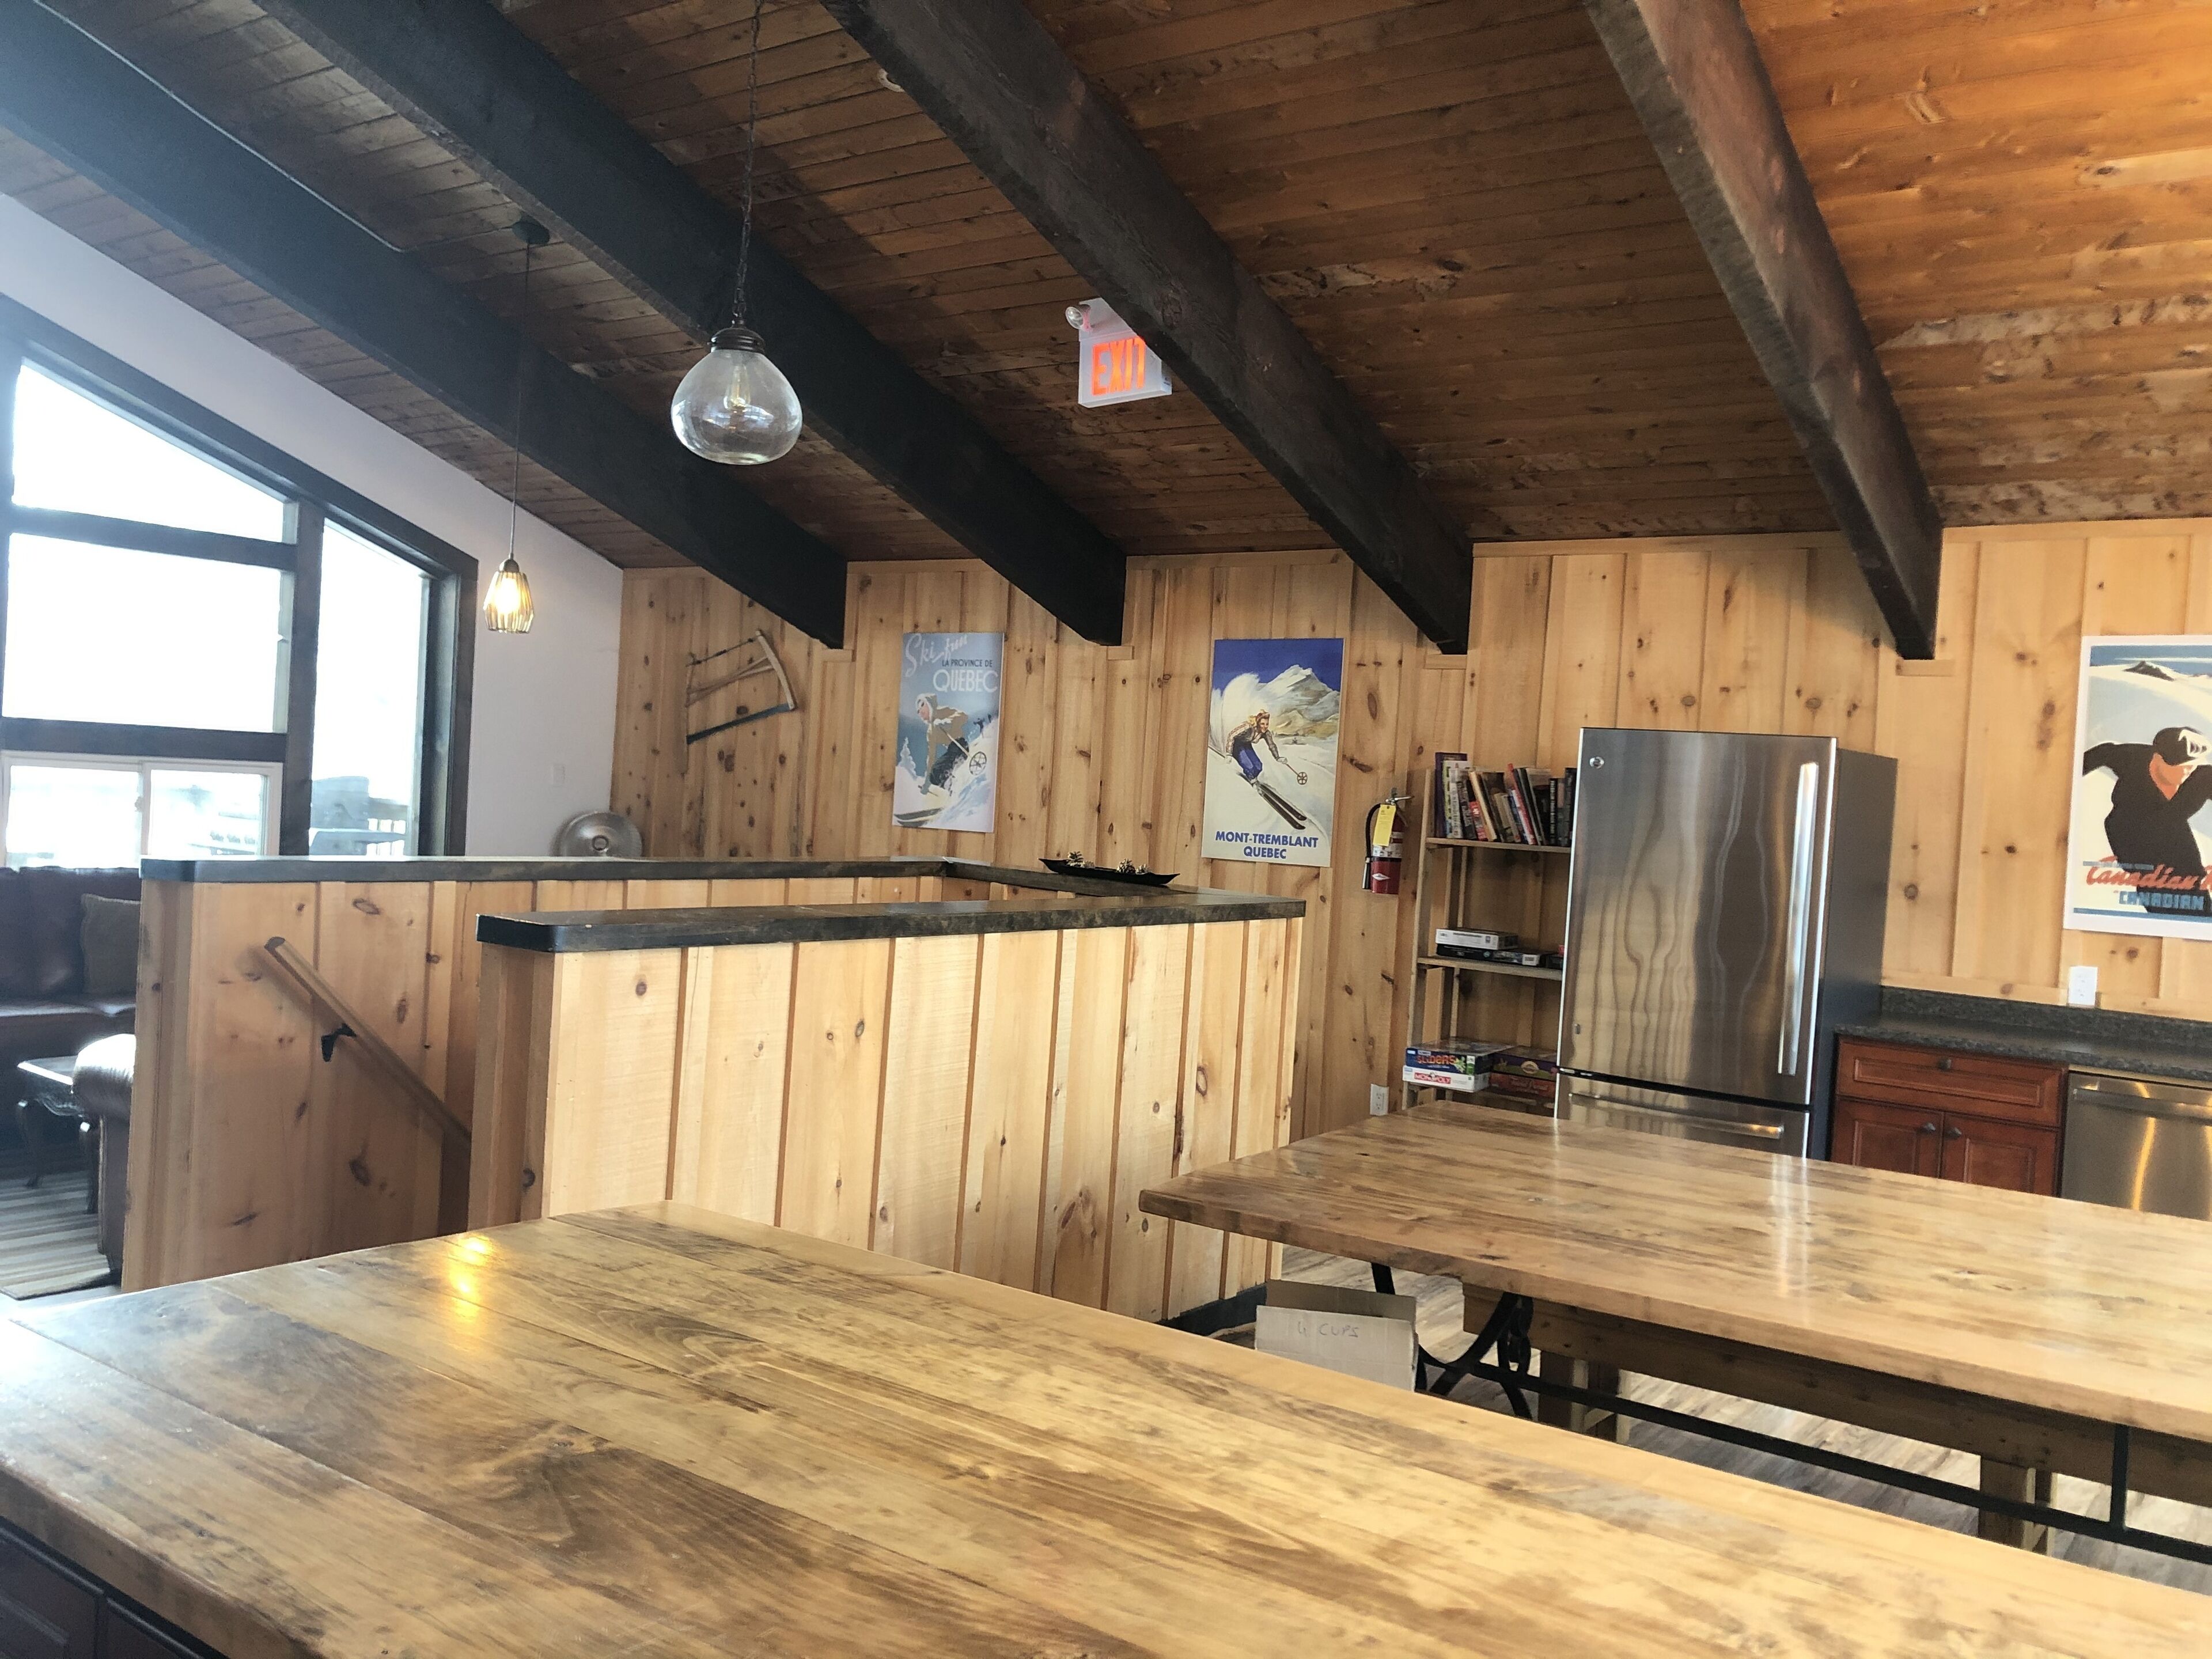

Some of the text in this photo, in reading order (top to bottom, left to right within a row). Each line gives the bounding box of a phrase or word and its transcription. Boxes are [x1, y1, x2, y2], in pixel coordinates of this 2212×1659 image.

[1092, 337, 1145, 396] EXIT
[905, 633, 935, 677] Ski
[951, 658, 982, 668] PROVINCE
[984, 660, 993, 668] DE
[933, 669, 998, 693] QUEBEC
[1215, 831, 1319, 848] MONT-TREMBLANT
[1244, 846, 1287, 859] QUEBEC
[2086, 855, 2199, 890] Canadian
